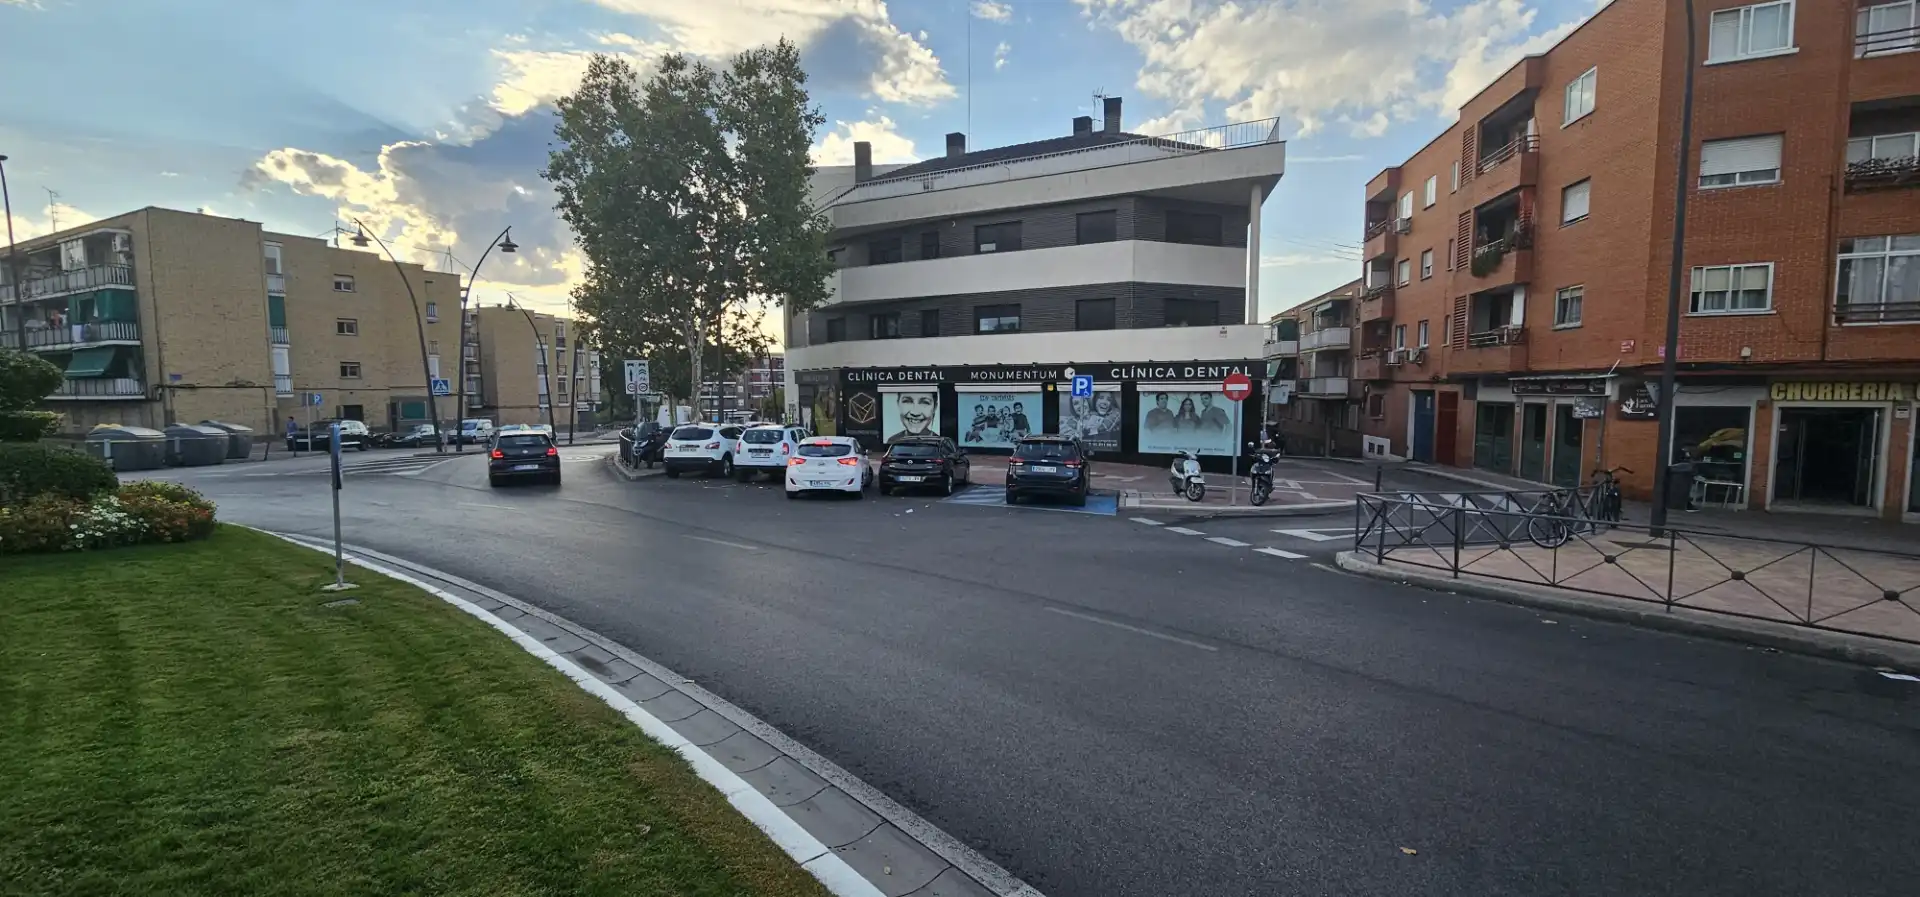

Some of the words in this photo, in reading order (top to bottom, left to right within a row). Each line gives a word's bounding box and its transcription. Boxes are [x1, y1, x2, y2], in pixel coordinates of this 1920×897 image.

[848, 370, 893, 381] CLÍNICA
[898, 371, 945, 380] DENTAL
[970, 370, 1057, 380] MONUMENTUM
[1111, 365, 1176, 379] CLÍNICA
[1075, 378, 1088, 395] P
[1770, 382, 1903, 400] CHURRERIA
